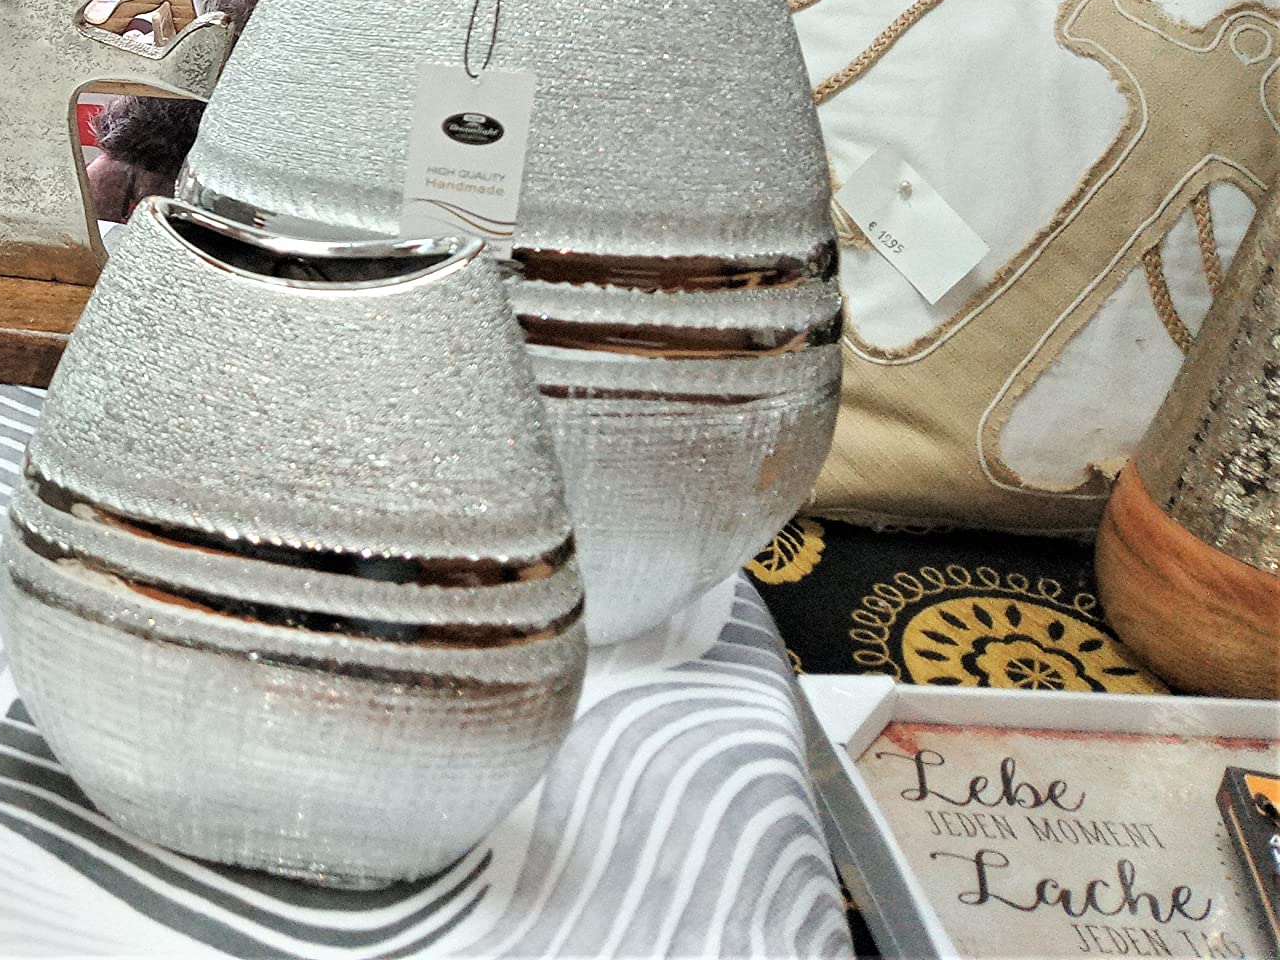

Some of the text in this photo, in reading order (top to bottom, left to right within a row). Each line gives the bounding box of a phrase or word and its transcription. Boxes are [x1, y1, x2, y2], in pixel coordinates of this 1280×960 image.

[425, 178, 505, 196] Handmade
[426, 166, 505, 181] HIGH QUALITY
[875, 749, 1086, 812] Lebe
[924, 809, 1166, 850] JEDEN MOMENT
[929, 848, 1213, 924] Lache
[1070, 923, 1173, 957] JEDEN
